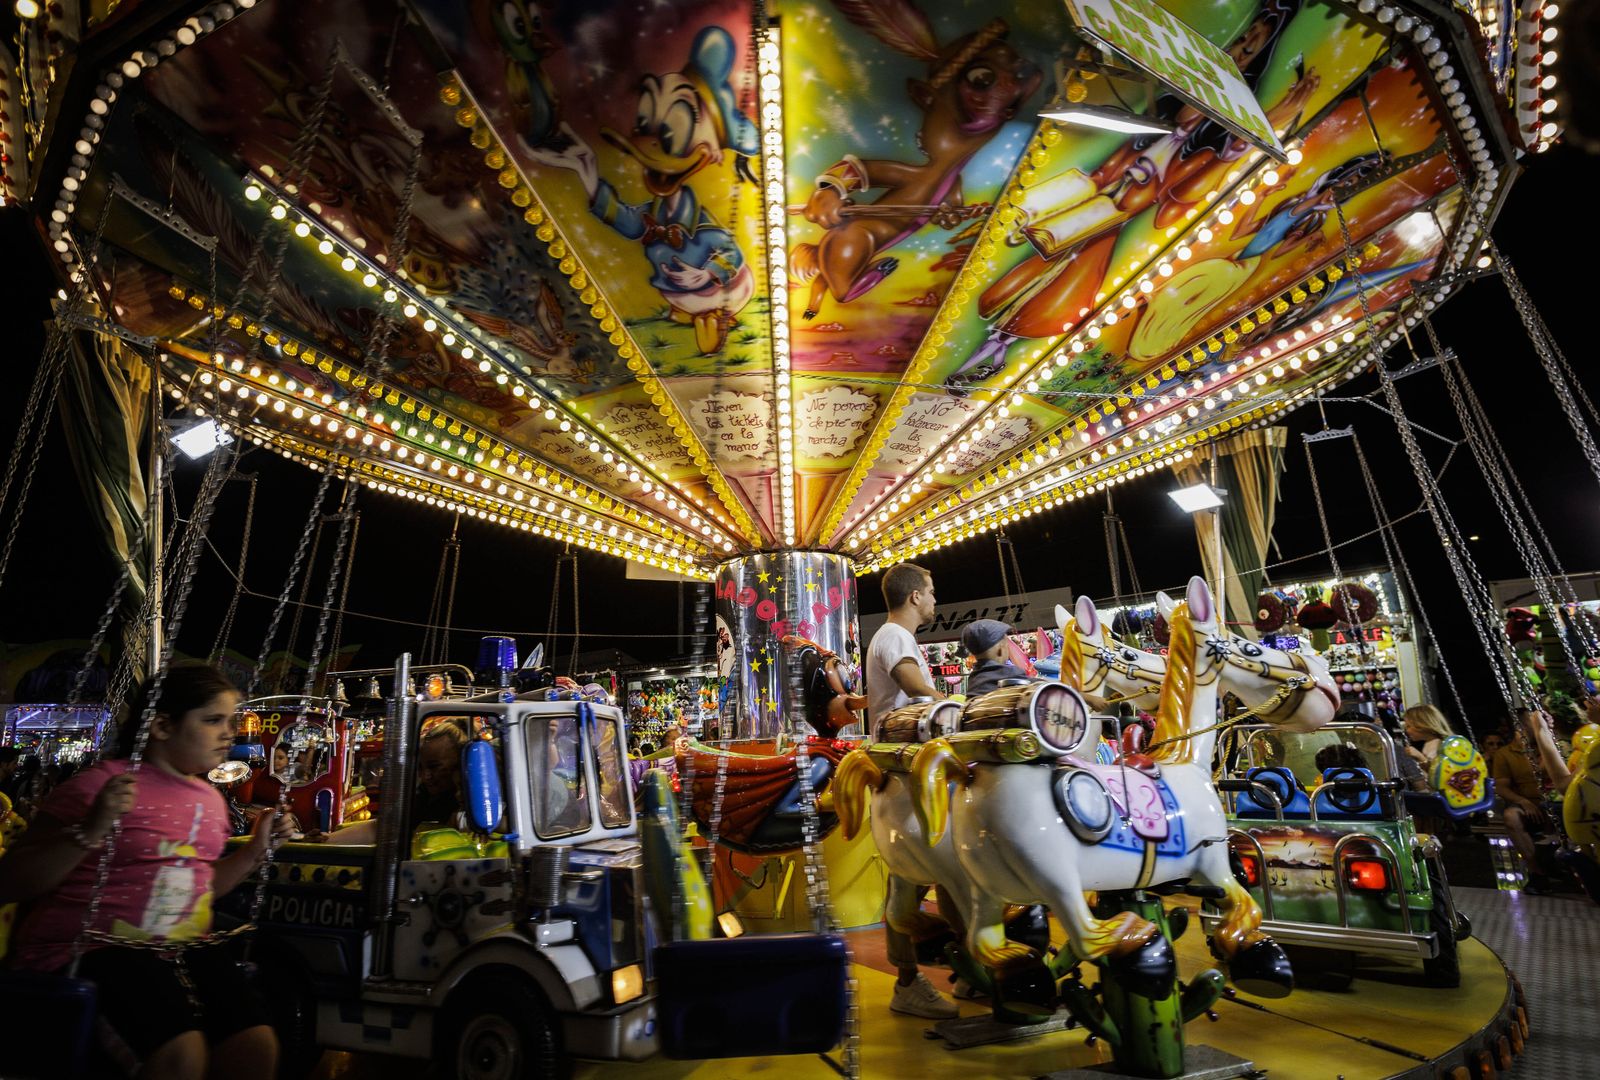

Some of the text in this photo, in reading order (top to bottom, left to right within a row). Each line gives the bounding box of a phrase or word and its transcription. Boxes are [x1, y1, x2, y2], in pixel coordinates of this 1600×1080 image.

[806, 397, 828, 412] No
[725, 442, 760, 452] mano
[268, 895, 355, 928] POLICIA
